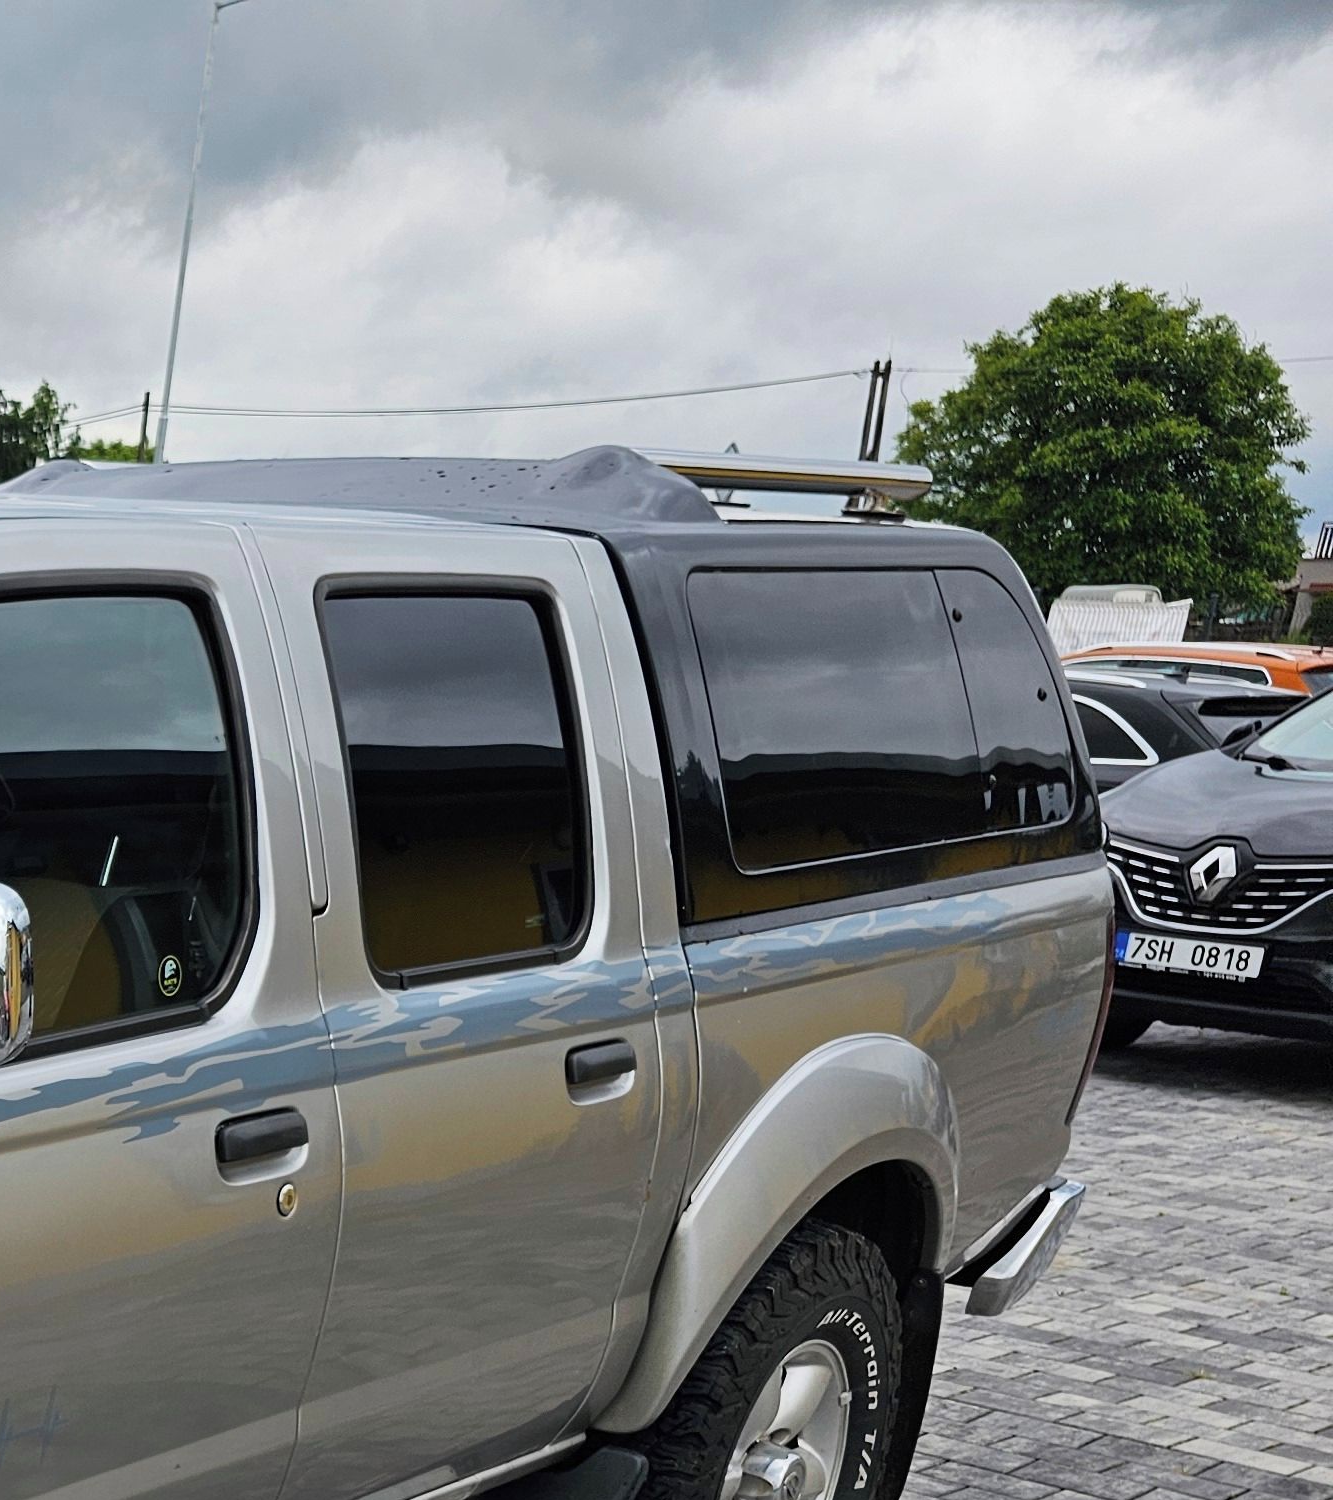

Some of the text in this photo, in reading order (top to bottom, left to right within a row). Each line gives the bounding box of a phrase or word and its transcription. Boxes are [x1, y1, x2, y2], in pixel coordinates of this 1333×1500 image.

[1131, 937, 1174, 962] 7SH
[1191, 944, 1251, 971] 0818
[816, 1308, 880, 1489] All-Terrain T/A
